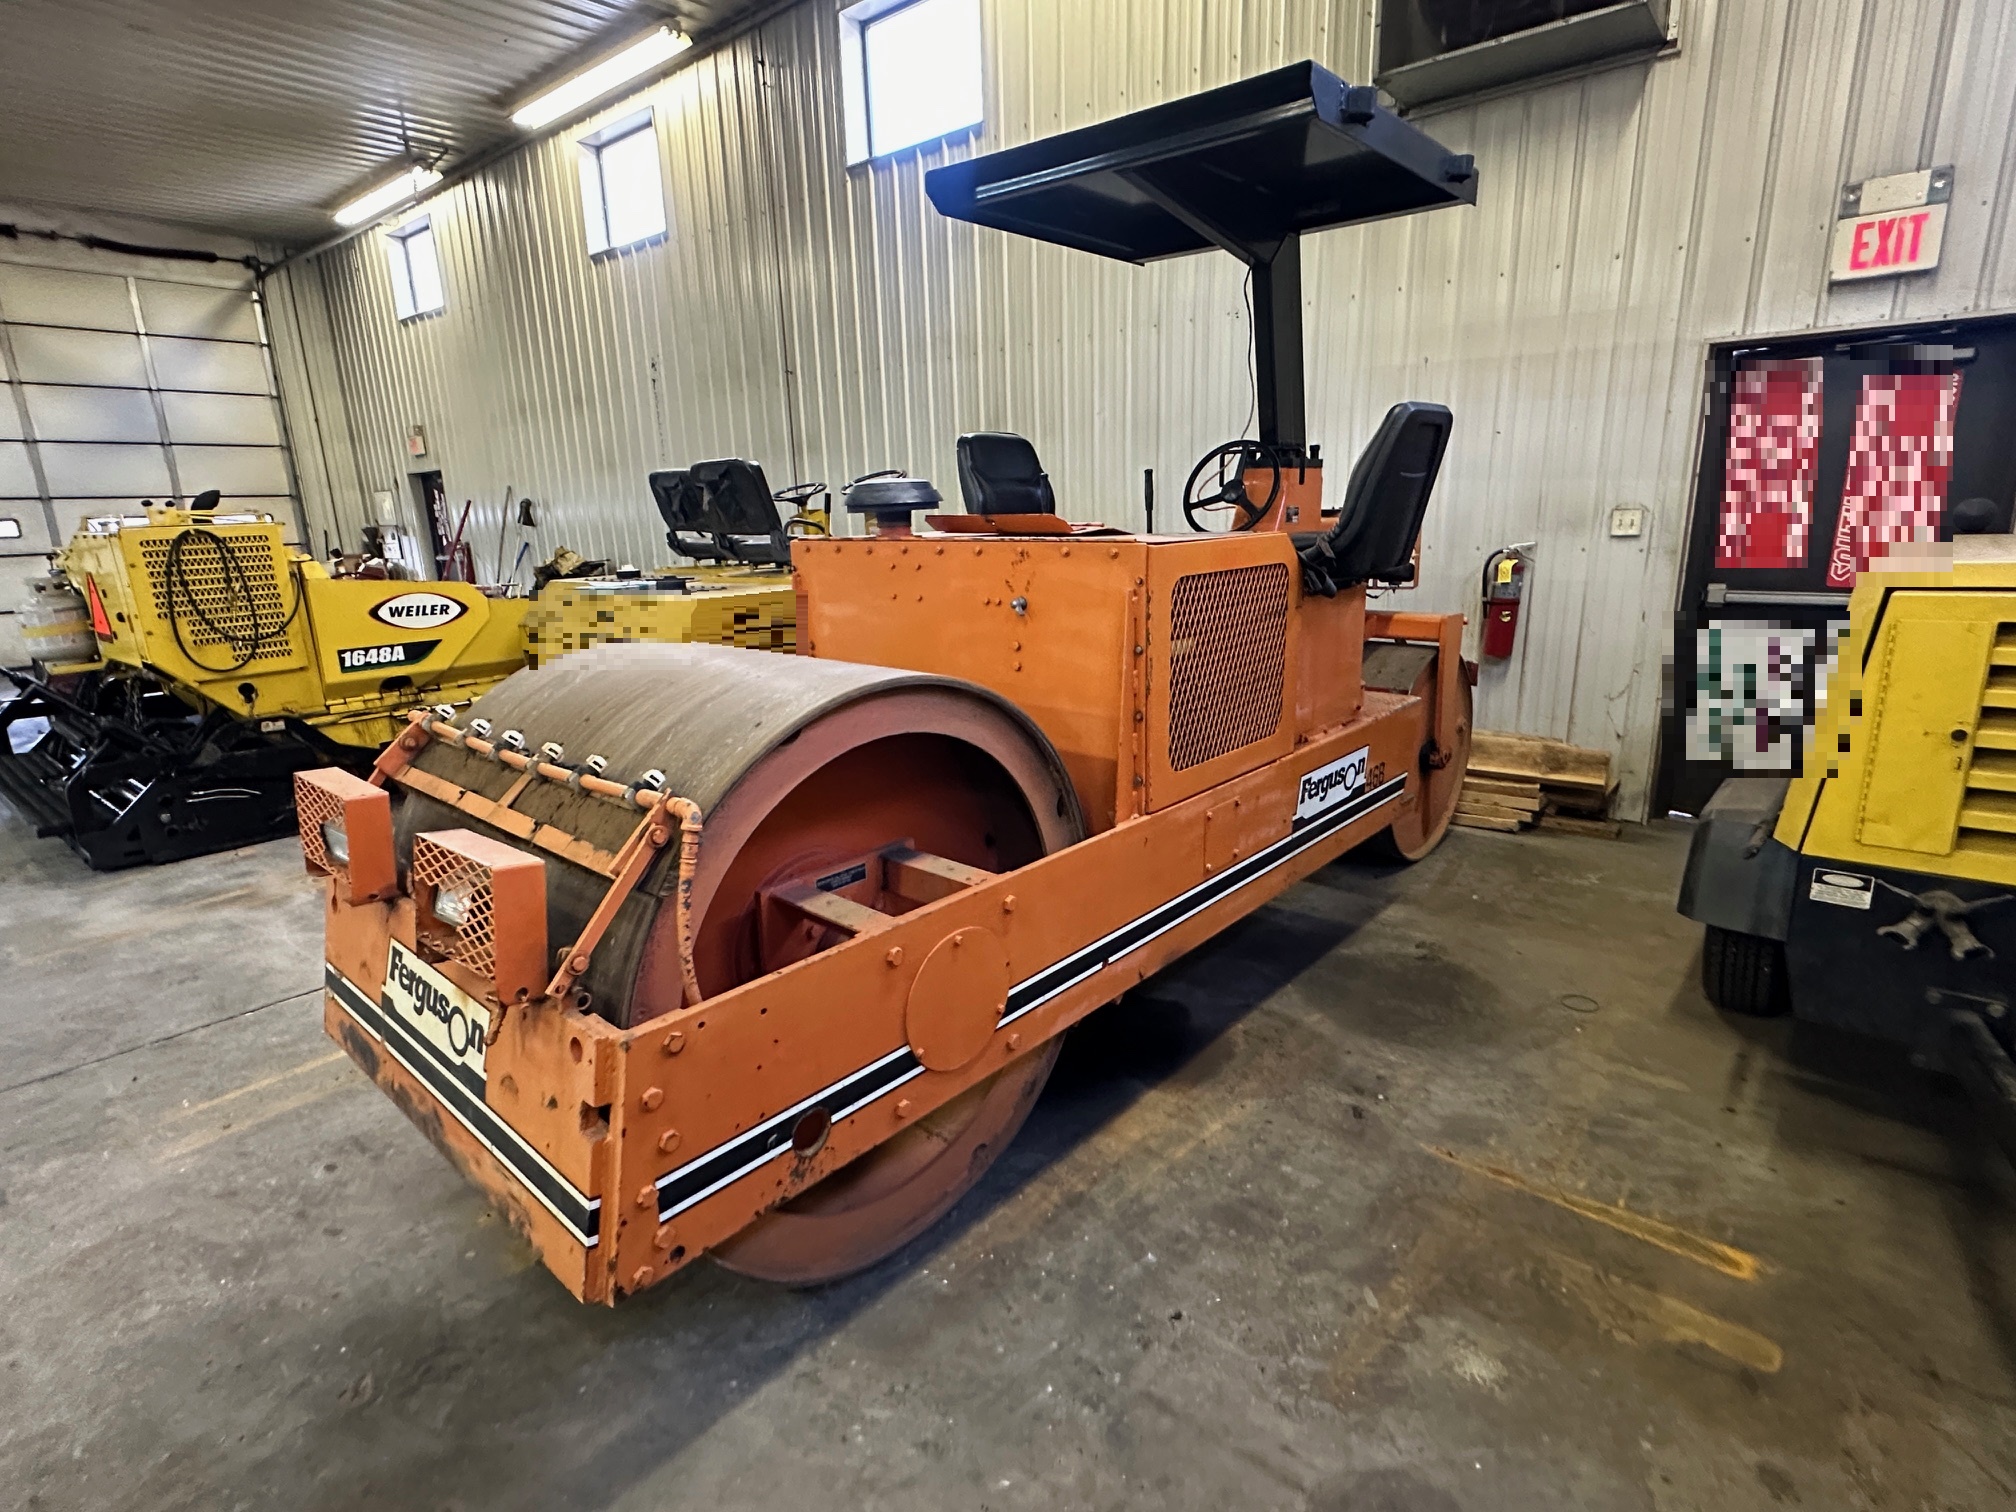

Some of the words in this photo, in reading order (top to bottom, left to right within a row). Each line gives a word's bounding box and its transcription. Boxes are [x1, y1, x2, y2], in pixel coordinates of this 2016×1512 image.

[1849, 211, 1930, 271] EXIT
[388, 604, 450, 618] WEILER
[340, 645, 406, 668] 1648A
[1299, 756, 1366, 806] Ferguson
[388, 944, 485, 1056] Ferguson
